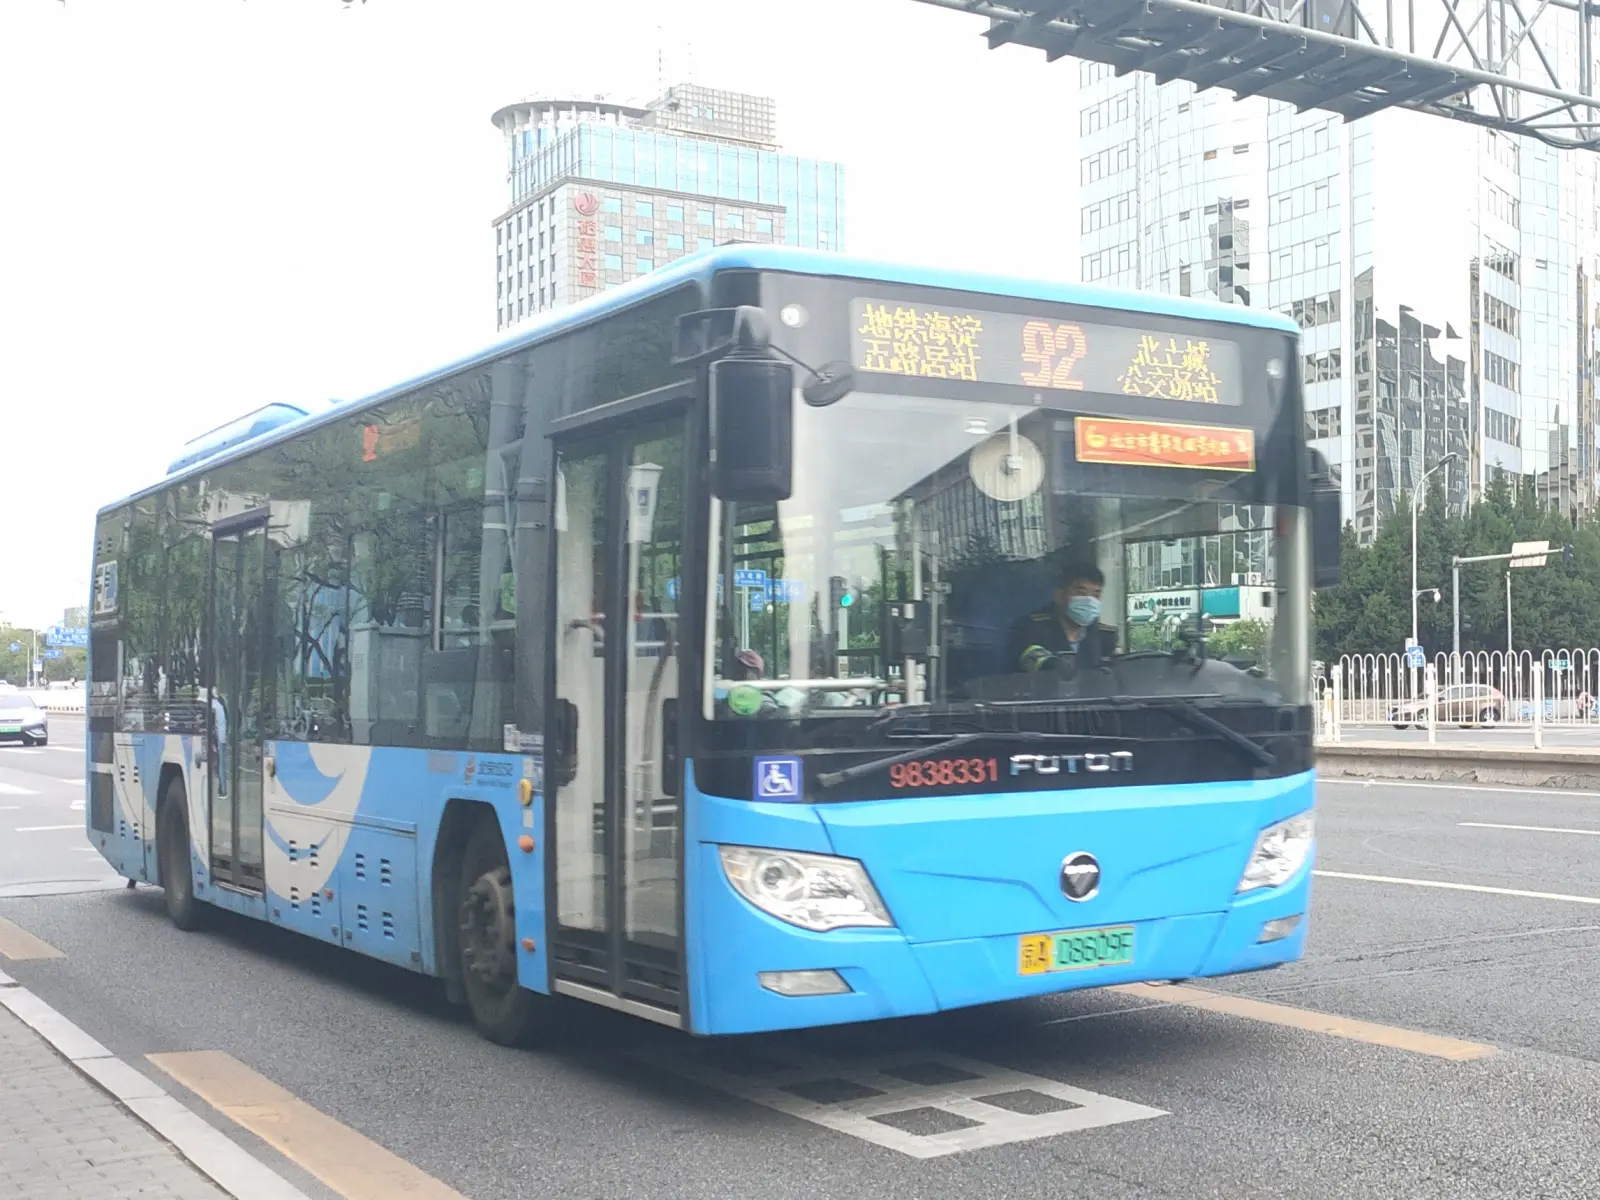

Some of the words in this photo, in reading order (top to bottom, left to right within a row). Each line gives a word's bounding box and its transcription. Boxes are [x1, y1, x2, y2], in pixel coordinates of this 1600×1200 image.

[858, 303, 983, 347] 地铁海淀
[859, 339, 982, 382] 五路居站
[1020, 320, 1087, 392] 92
[1131, 335, 1211, 373] 北土城
[1116, 363, 1222, 404] 公交场站
[889, 758, 998, 788] 9838331
[1009, 751, 1133, 776] FOTON
